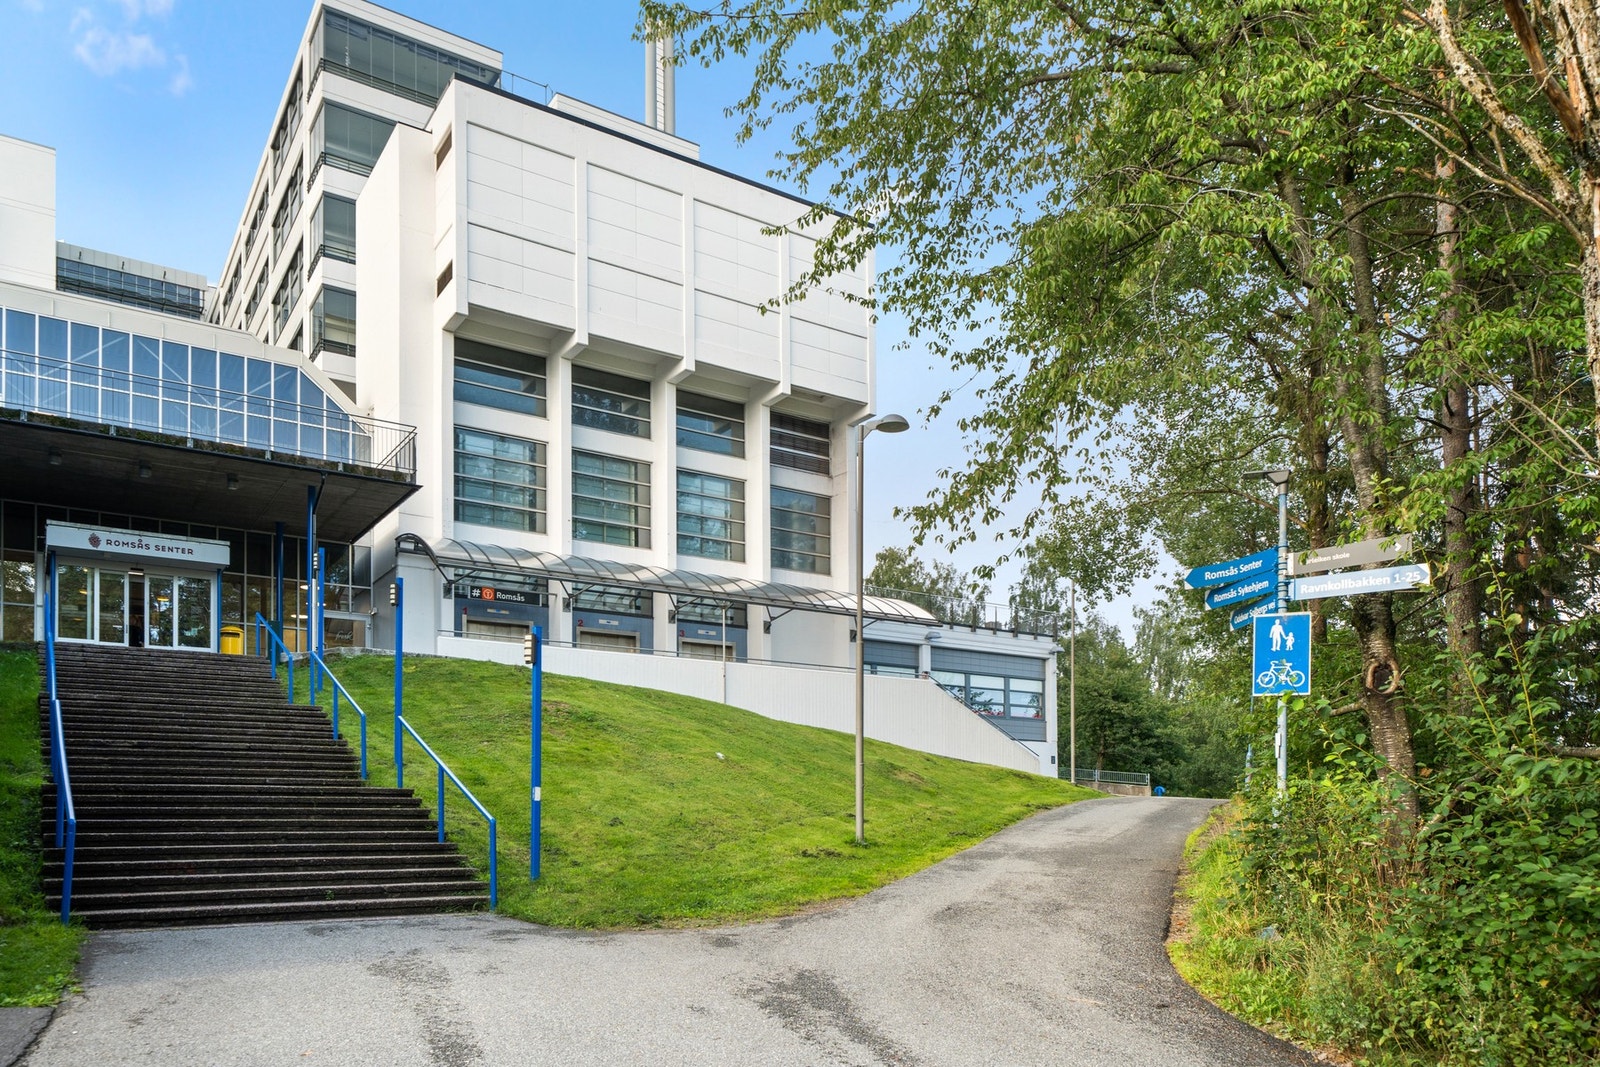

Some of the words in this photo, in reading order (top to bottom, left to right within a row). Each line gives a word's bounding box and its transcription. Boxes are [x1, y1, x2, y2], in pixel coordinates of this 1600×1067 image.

[105, 538, 151, 551] ROMSÅS
[154, 544, 194, 556] SENTER
[1332, 551, 1351, 561] skole
[1204, 566, 1239, 580] Romsås
[1239, 559, 1263, 573] Senter
[1300, 576, 1390, 594] Ravnkollbakken
[1393, 571, 1421, 584] 1-25
[496, 591, 525, 602] Romsås
[1213, 588, 1238, 603] Romsås
[1238, 580, 1269, 596] Sykehjem
[1266, 598, 1276, 610] vei
[462, 606, 468, 615] 1
[577, 618, 584, 627] 2
[679, 629, 685, 637] 3
